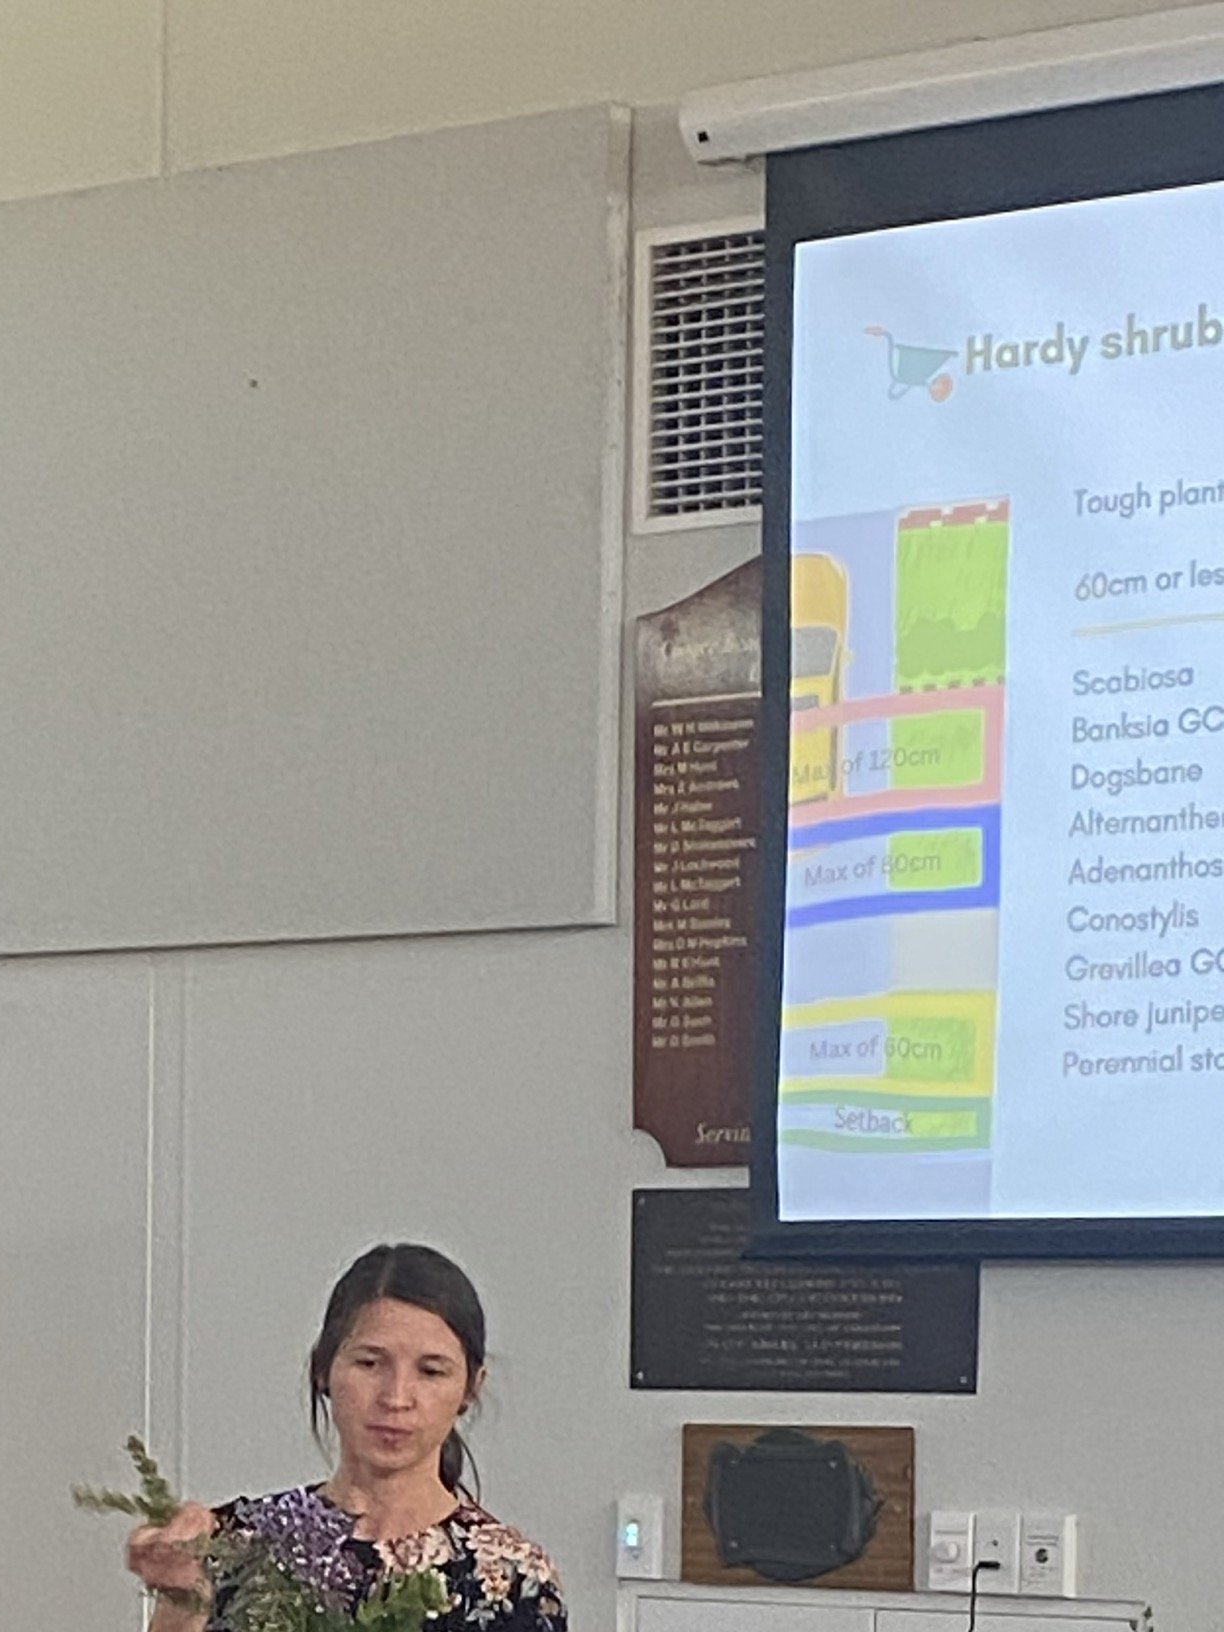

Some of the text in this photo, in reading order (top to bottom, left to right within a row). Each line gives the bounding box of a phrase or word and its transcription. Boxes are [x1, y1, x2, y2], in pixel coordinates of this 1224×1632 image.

[966, 304, 1224, 375] Hardy shrub
[1076, 482, 1151, 519] Tough
[1076, 561, 1224, 601] 60cm or les
[1073, 665, 1194, 696] Scabiosa
[1072, 713, 1170, 744] Banksia
[843, 755, 863, 775] of
[869, 747, 941, 771] 120cm
[1071, 762, 1202, 795] Dogsbane
[1068, 808, 1224, 838] Alternanthe
[804, 863, 851, 888] Max
[853, 856, 878, 877] of
[1068, 855, 1224, 886] Adenanthos
[1067, 902, 1199, 937] Conostylis
[1066, 952, 1181, 982] Grevillea
[1064, 1000, 1224, 1034] Shore junipe
[810, 1040, 852, 1060] Max
[856, 1034, 879, 1058] of
[1062, 1046, 1182, 1077] Perennial
[834, 1105, 915, 1134] Setback
